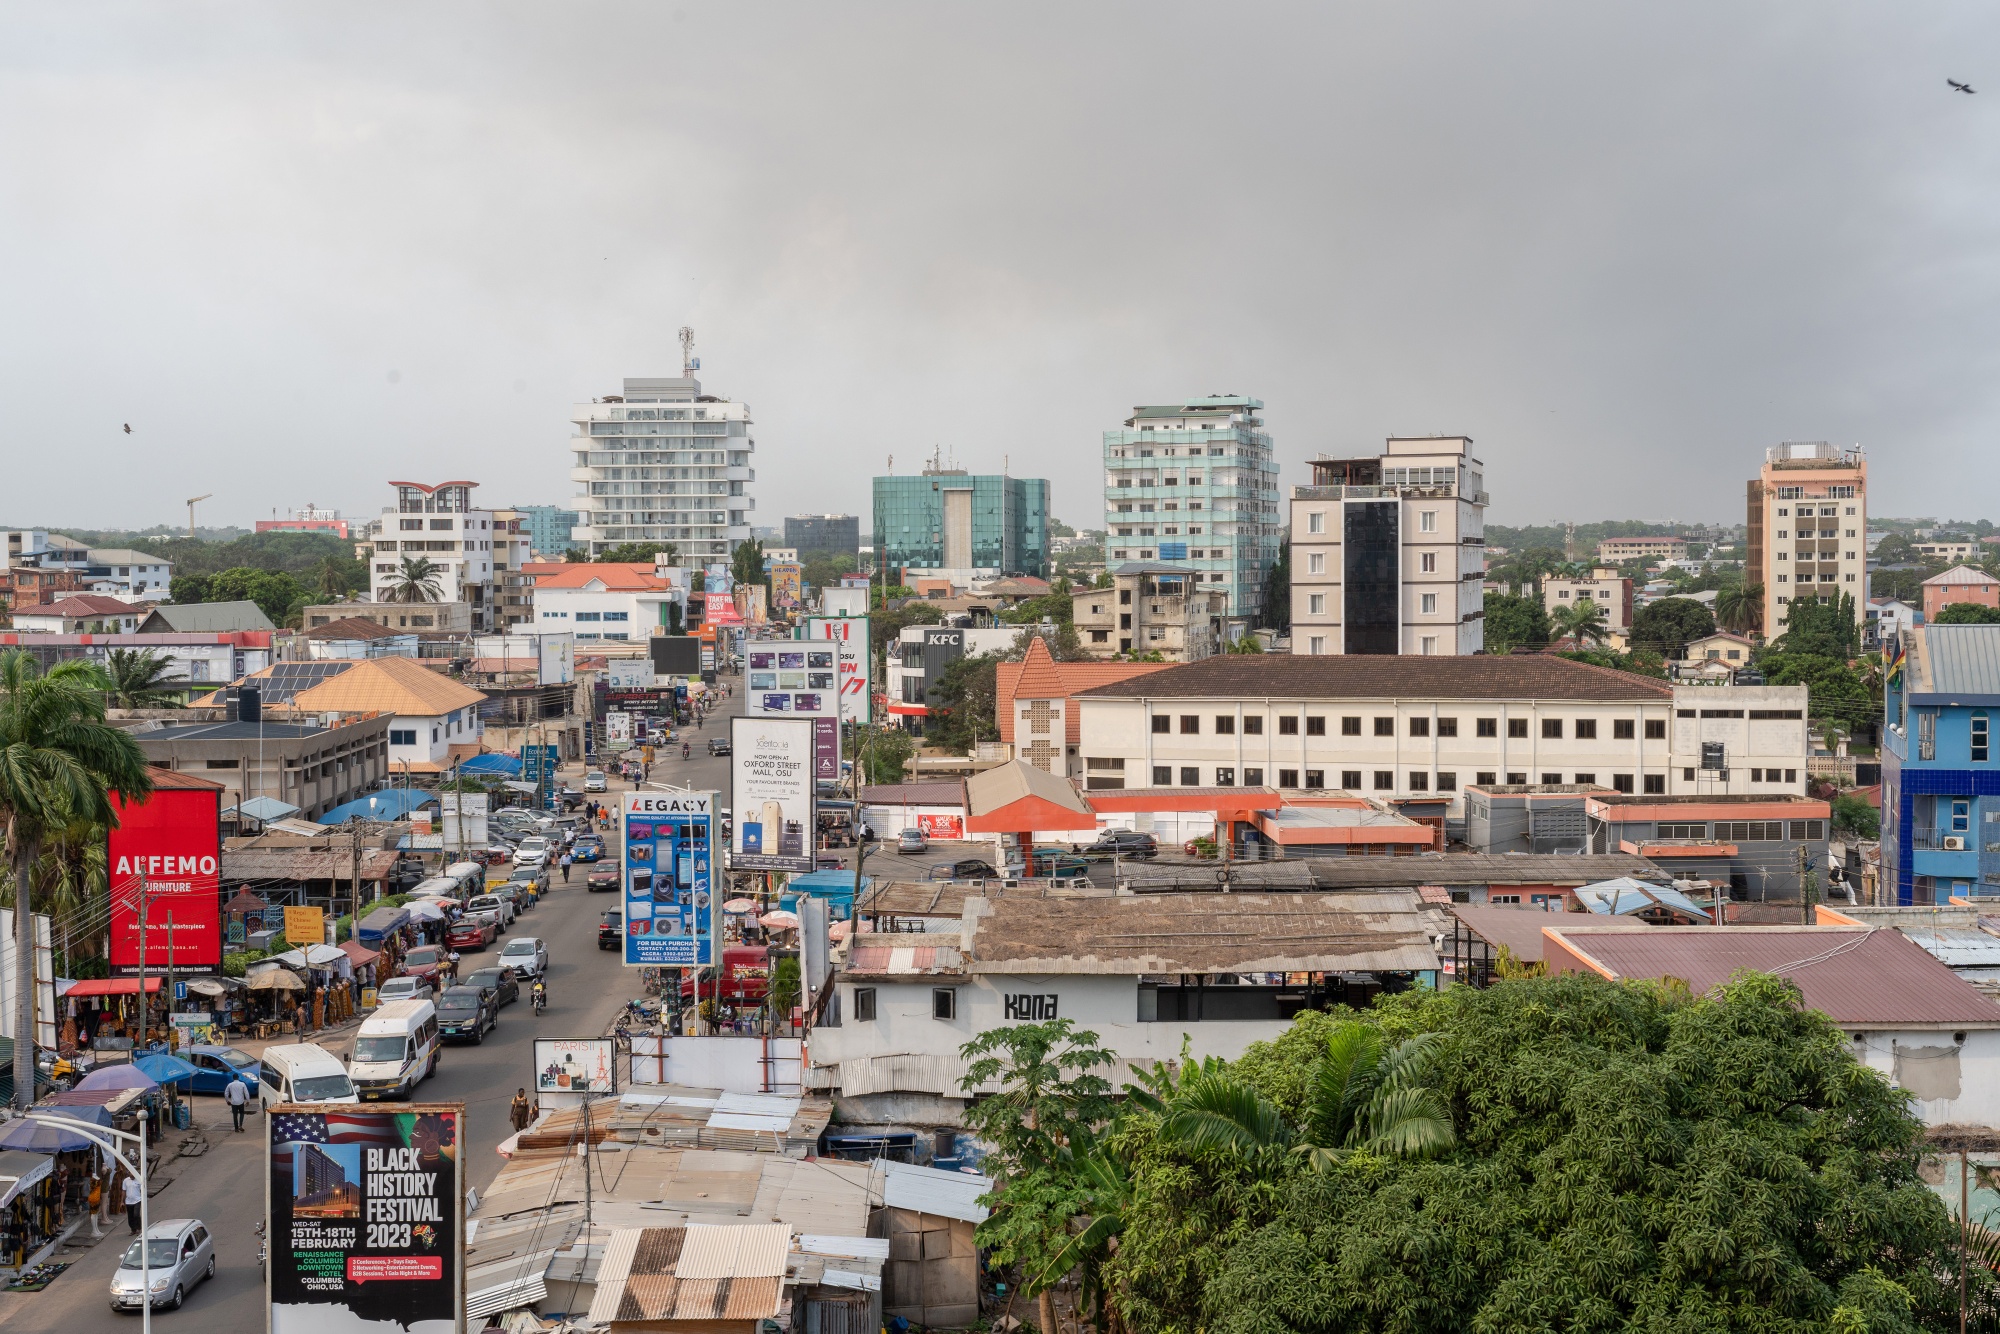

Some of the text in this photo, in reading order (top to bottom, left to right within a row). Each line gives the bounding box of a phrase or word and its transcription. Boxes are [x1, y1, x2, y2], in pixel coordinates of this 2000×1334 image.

[928, 635, 959, 645] KFC
[840, 663, 858, 672] EN
[632, 799, 706, 811] LEGACY
[367, 1148, 420, 1171] BLACK
[367, 1173, 437, 1197] HISTORY
[367, 1198, 443, 1222] FESTIVAL
[291, 1228, 355, 1237] 15TH-18TH
[367, 1224, 411, 1248] 2023
[292, 1239, 356, 1248] FEBRUARY
